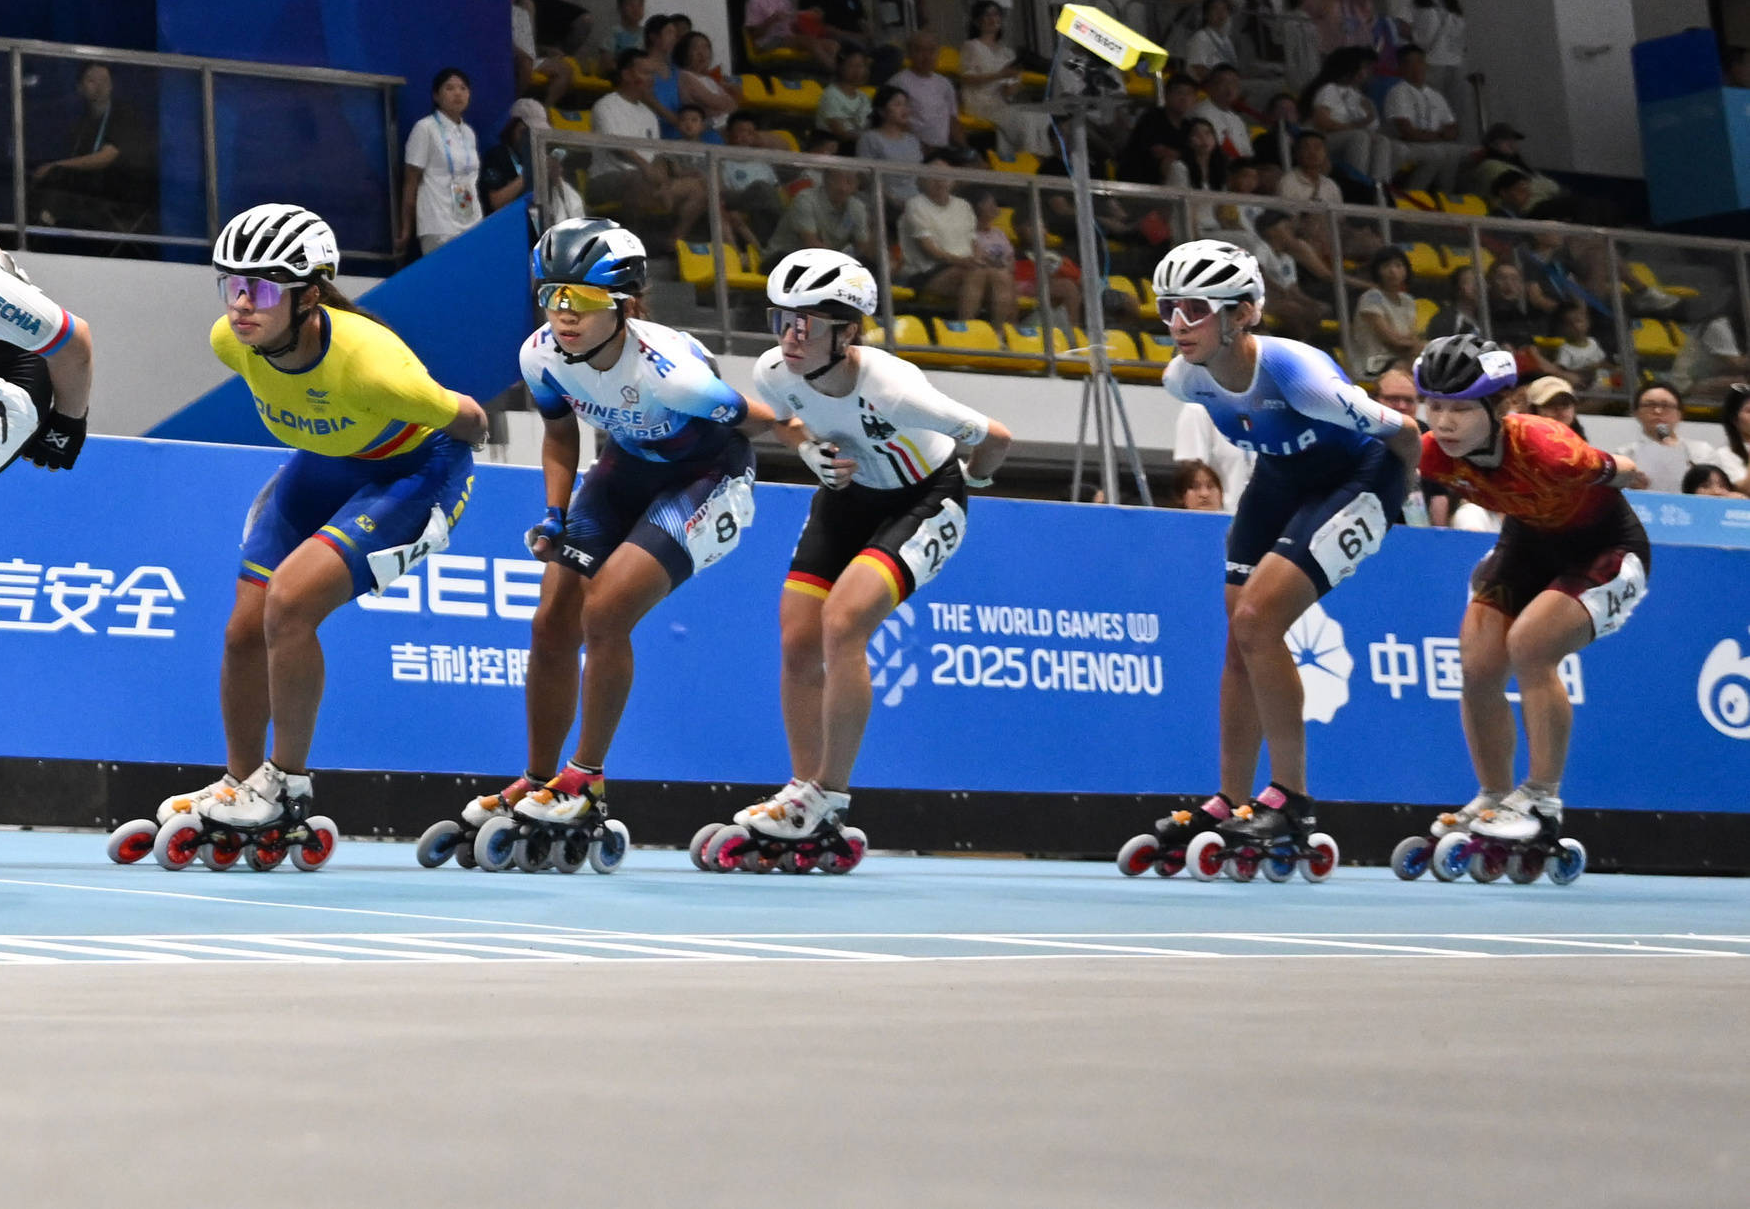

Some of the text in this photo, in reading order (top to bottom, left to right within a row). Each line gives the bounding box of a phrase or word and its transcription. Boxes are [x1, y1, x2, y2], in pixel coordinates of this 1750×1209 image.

[253, 395, 357, 436] OLOMBIA
[1235, 429, 1318, 456] ALIA
[716, 511, 738, 543] 8
[923, 521, 958, 573] 29
[1338, 507, 1374, 560] 61
[392, 541, 431, 576] 14
[562, 544, 595, 568] TPE
[356, 553, 547, 620] GEE
[927, 602, 1125, 641] THE WORLD GAMES
[931, 643, 1164, 696] 2025 CHENGDU
